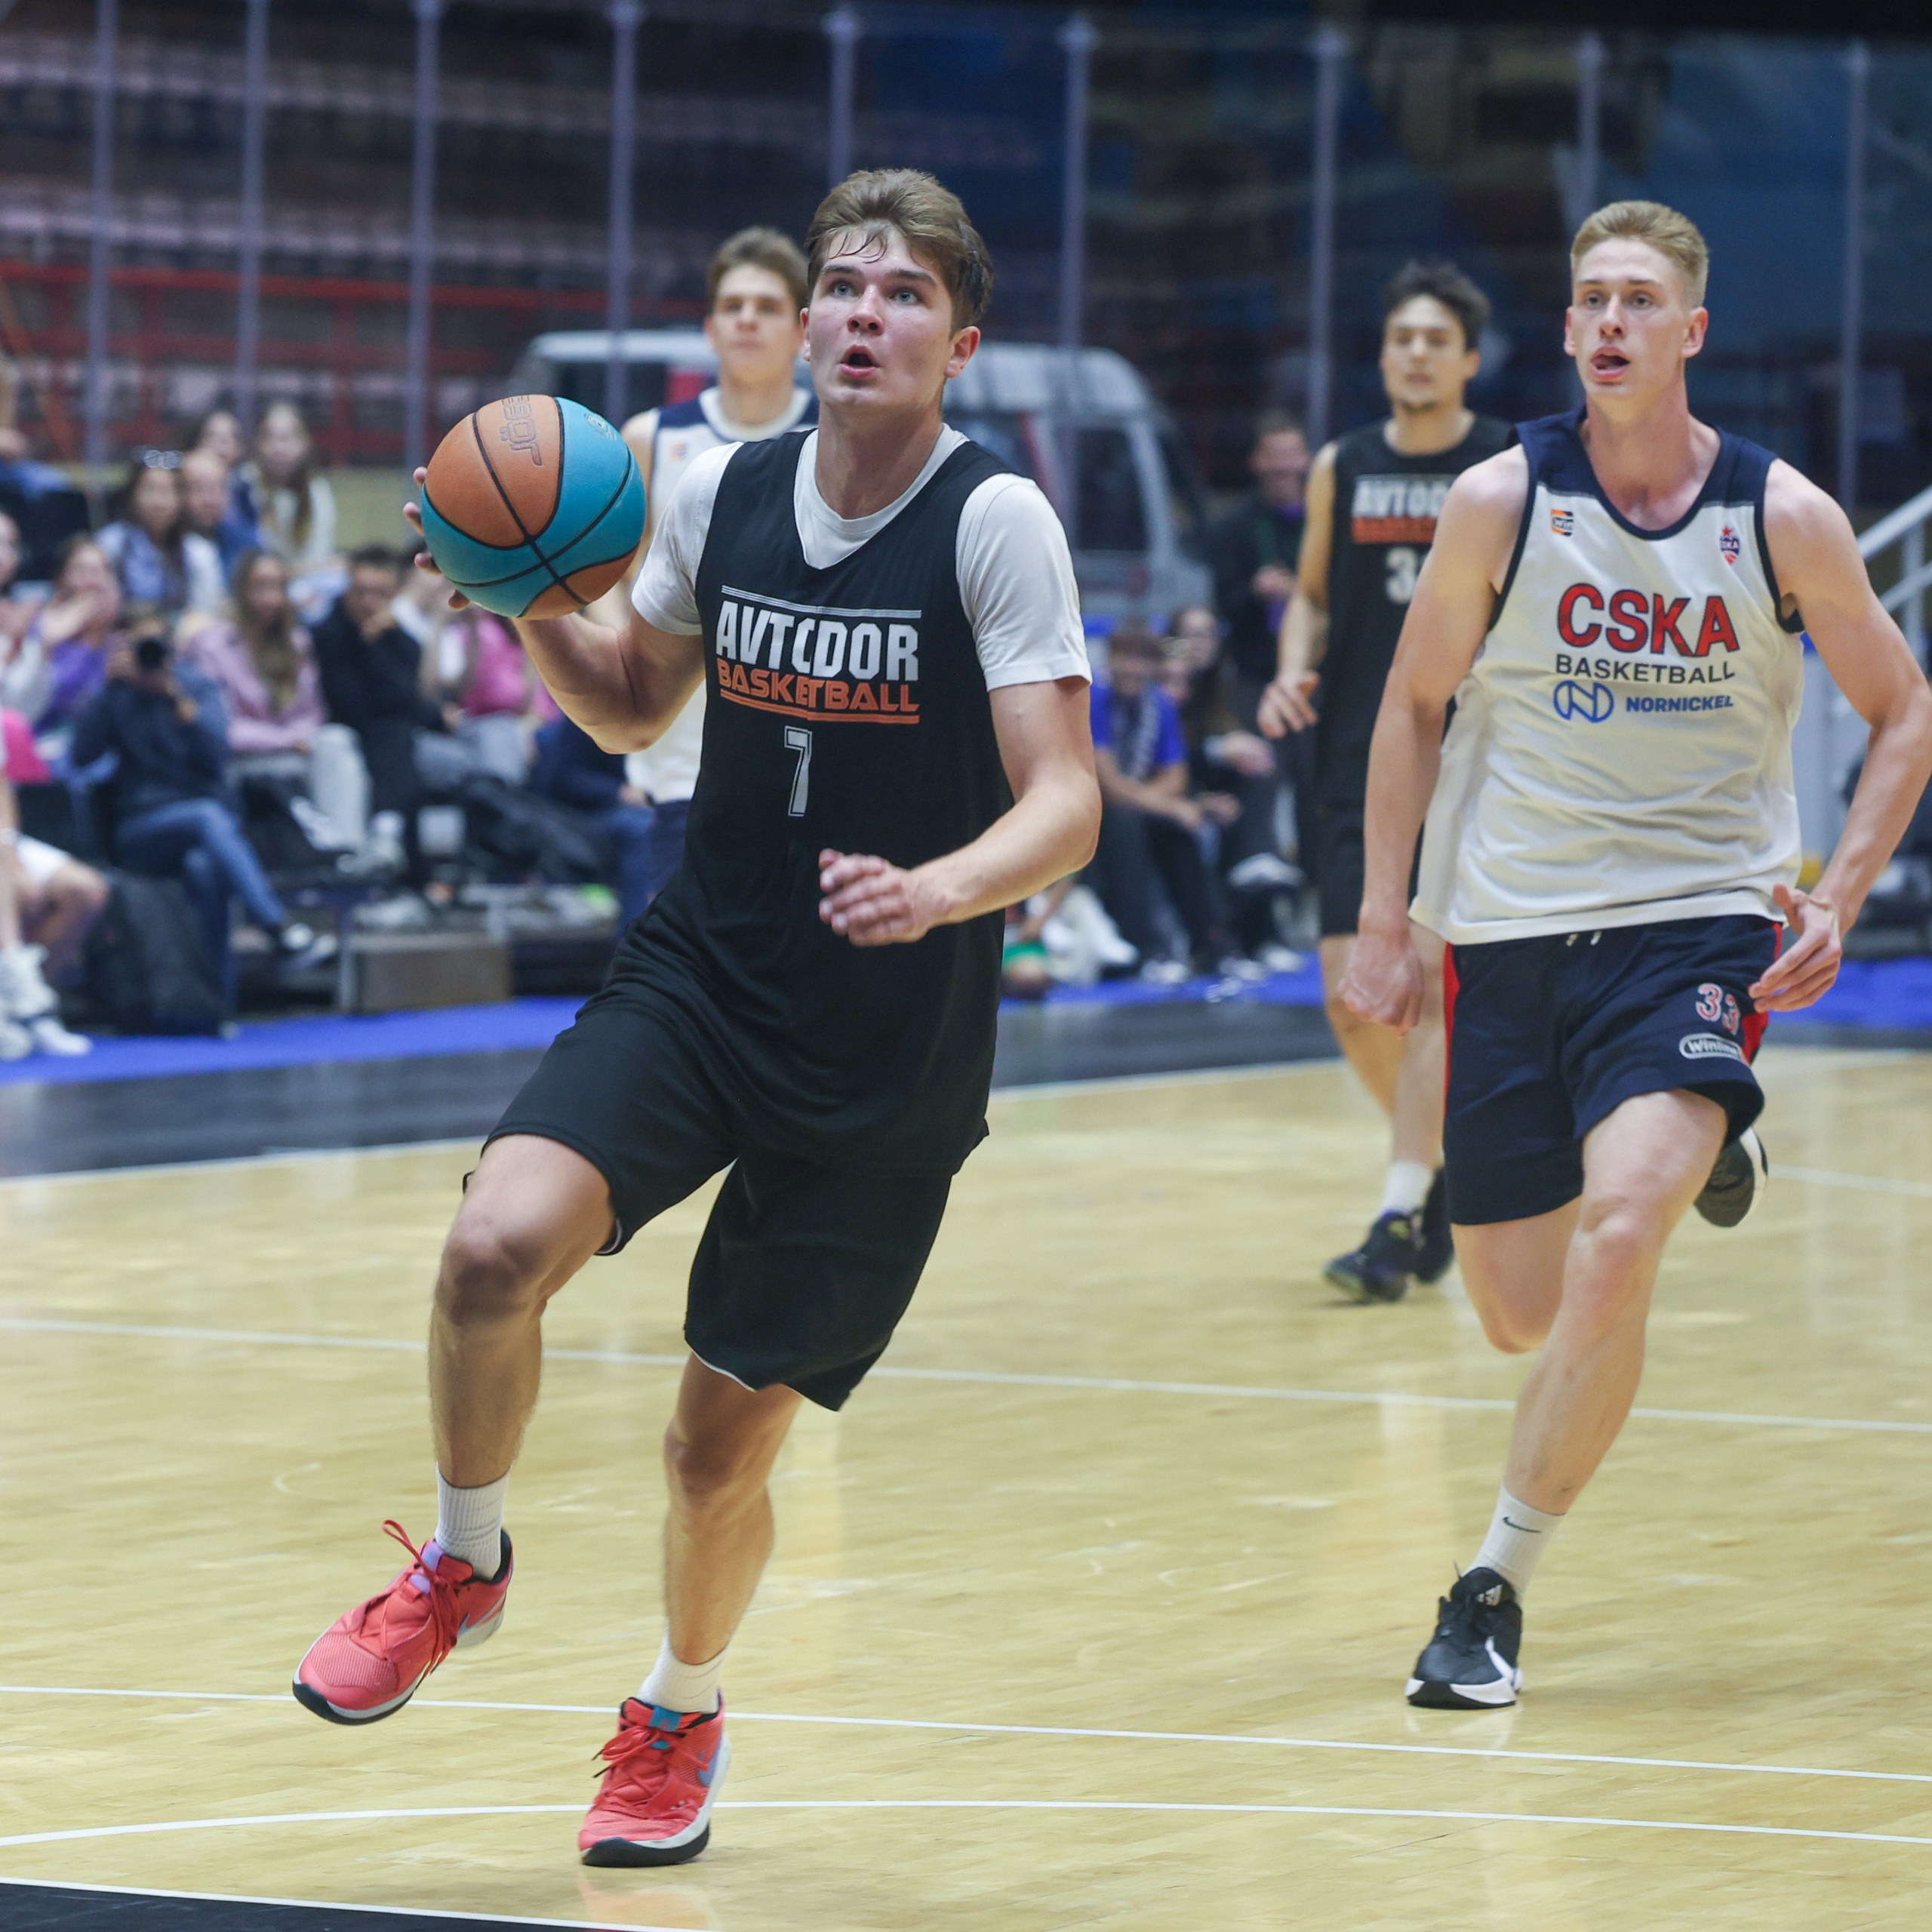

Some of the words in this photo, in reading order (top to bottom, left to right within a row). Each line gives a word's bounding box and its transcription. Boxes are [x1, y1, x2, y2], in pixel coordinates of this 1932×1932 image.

[1557, 583, 1740, 657] CSKA
[717, 657, 919, 712] BASKETBALL
[1555, 654, 1735, 685] BASKETBALL
[1626, 694, 1734, 713] NORNICKEL
[784, 725, 812, 817] 7
